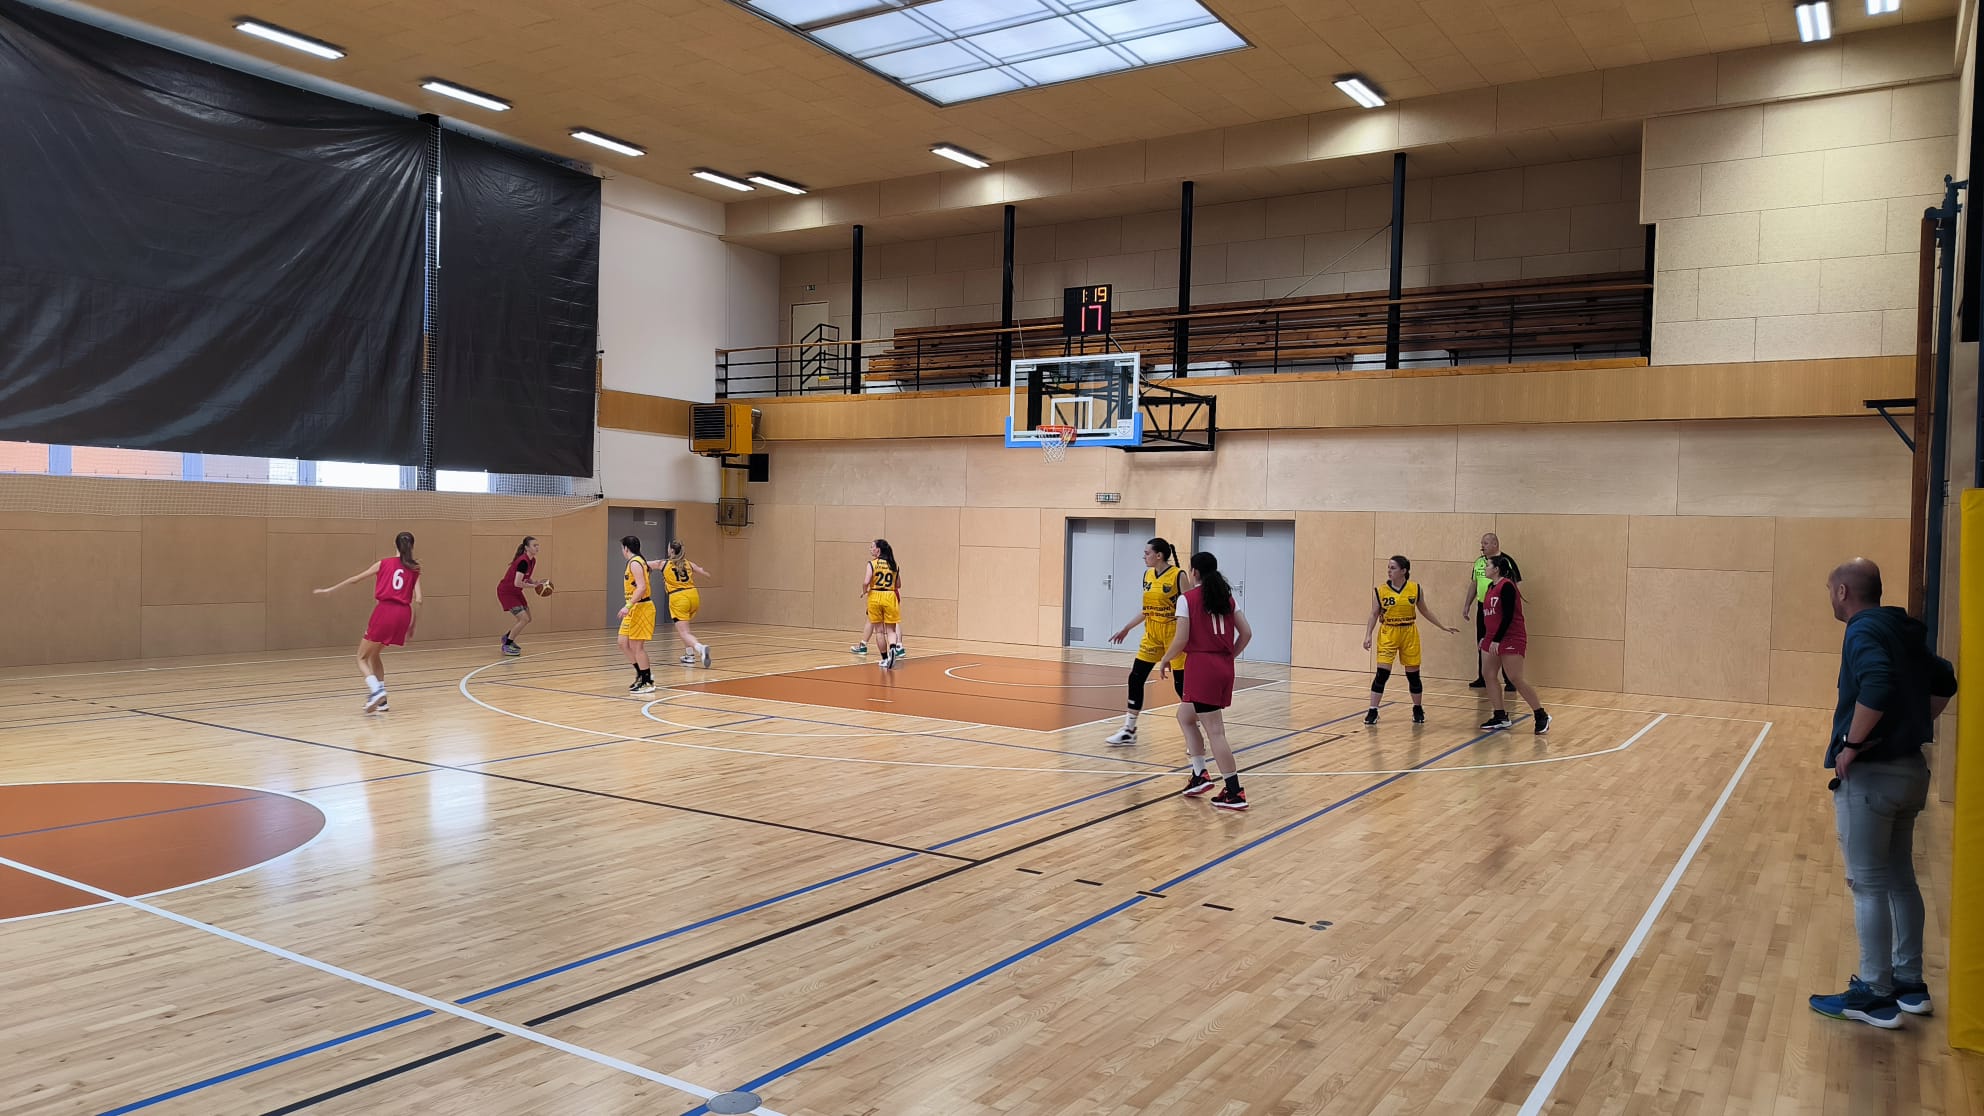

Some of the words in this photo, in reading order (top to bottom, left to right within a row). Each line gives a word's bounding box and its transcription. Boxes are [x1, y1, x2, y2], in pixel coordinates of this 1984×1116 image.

[1082, 286, 1107, 303] 1:19
[1081, 304, 1102, 332] 17
[392, 568, 404, 590] 6
[875, 571, 893, 587] 29
[1382, 596, 1396, 606] 28
[1490, 596, 1499, 607] 17
[1207, 610, 1225, 635] 11
